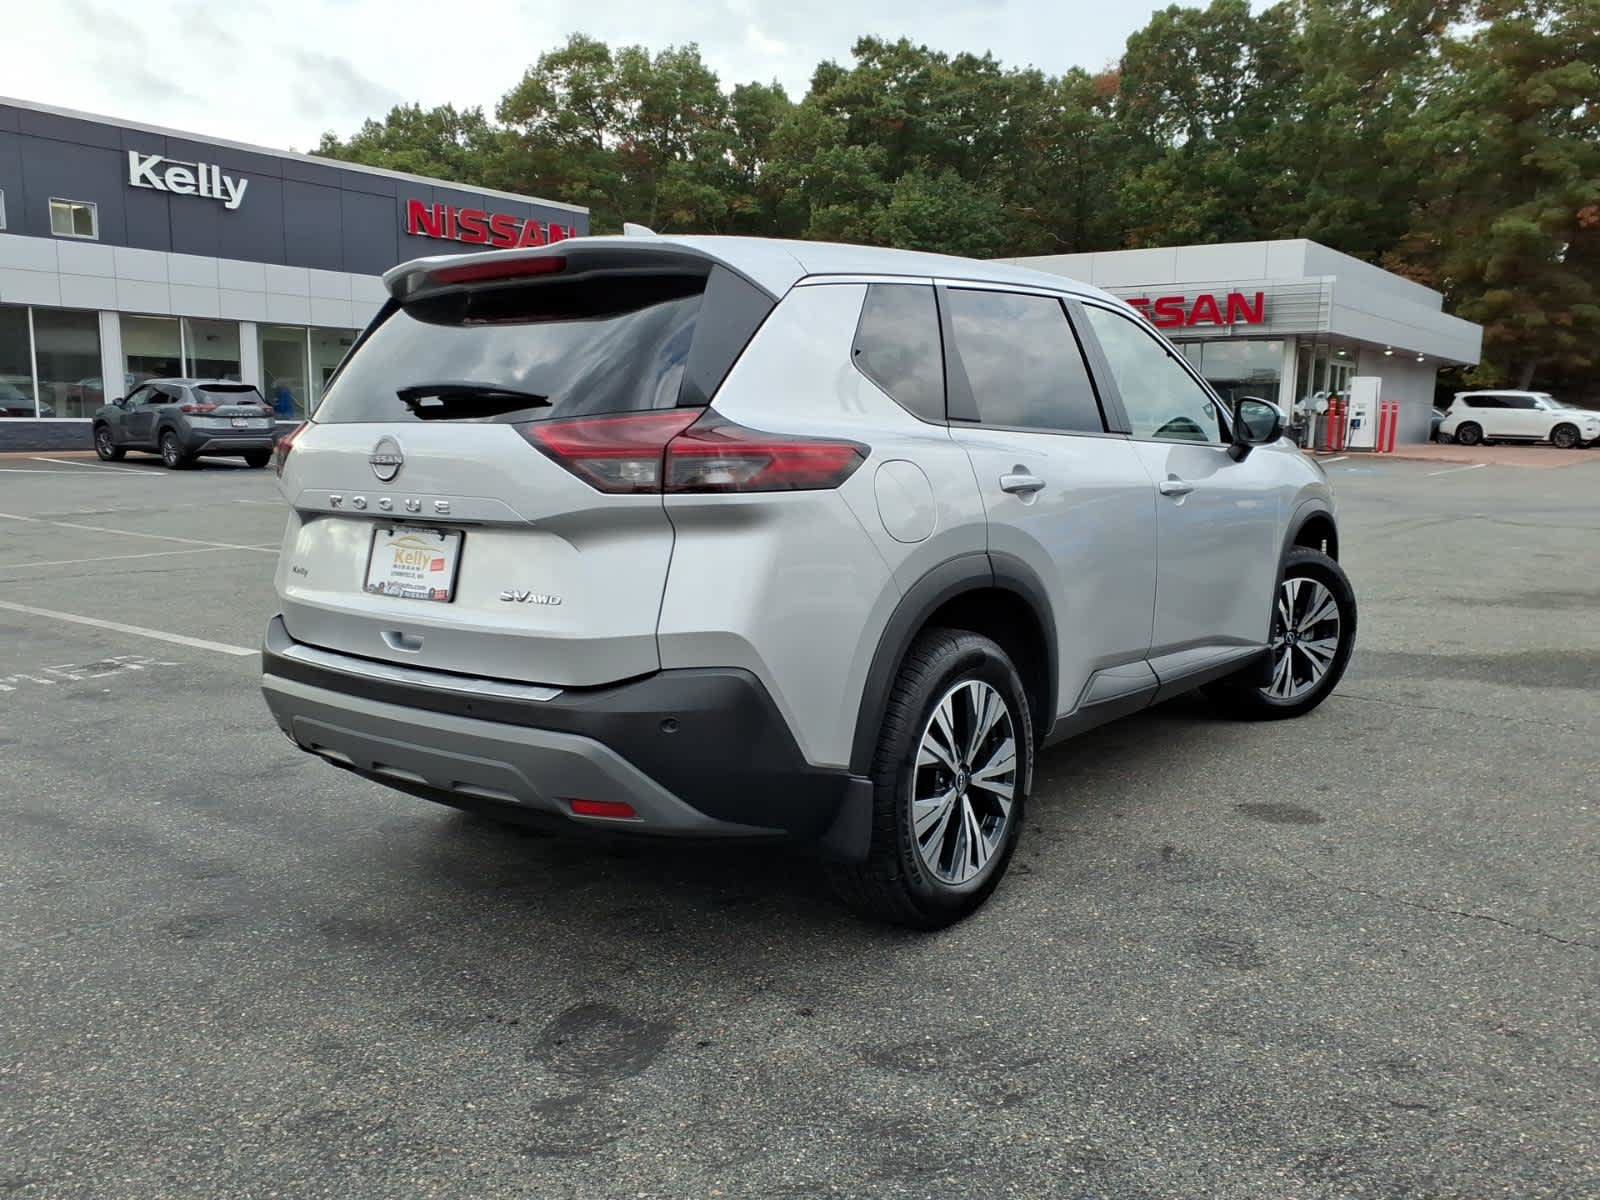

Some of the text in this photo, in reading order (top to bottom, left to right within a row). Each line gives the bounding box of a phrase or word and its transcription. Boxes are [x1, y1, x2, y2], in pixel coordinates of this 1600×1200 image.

[128, 150, 248, 210] Kelly
[1124, 292, 1264, 328] SSAN
[329, 495, 450, 514] ROGUE
[394, 549, 431, 570] Kelly
[527, 594, 562, 606] AWD
